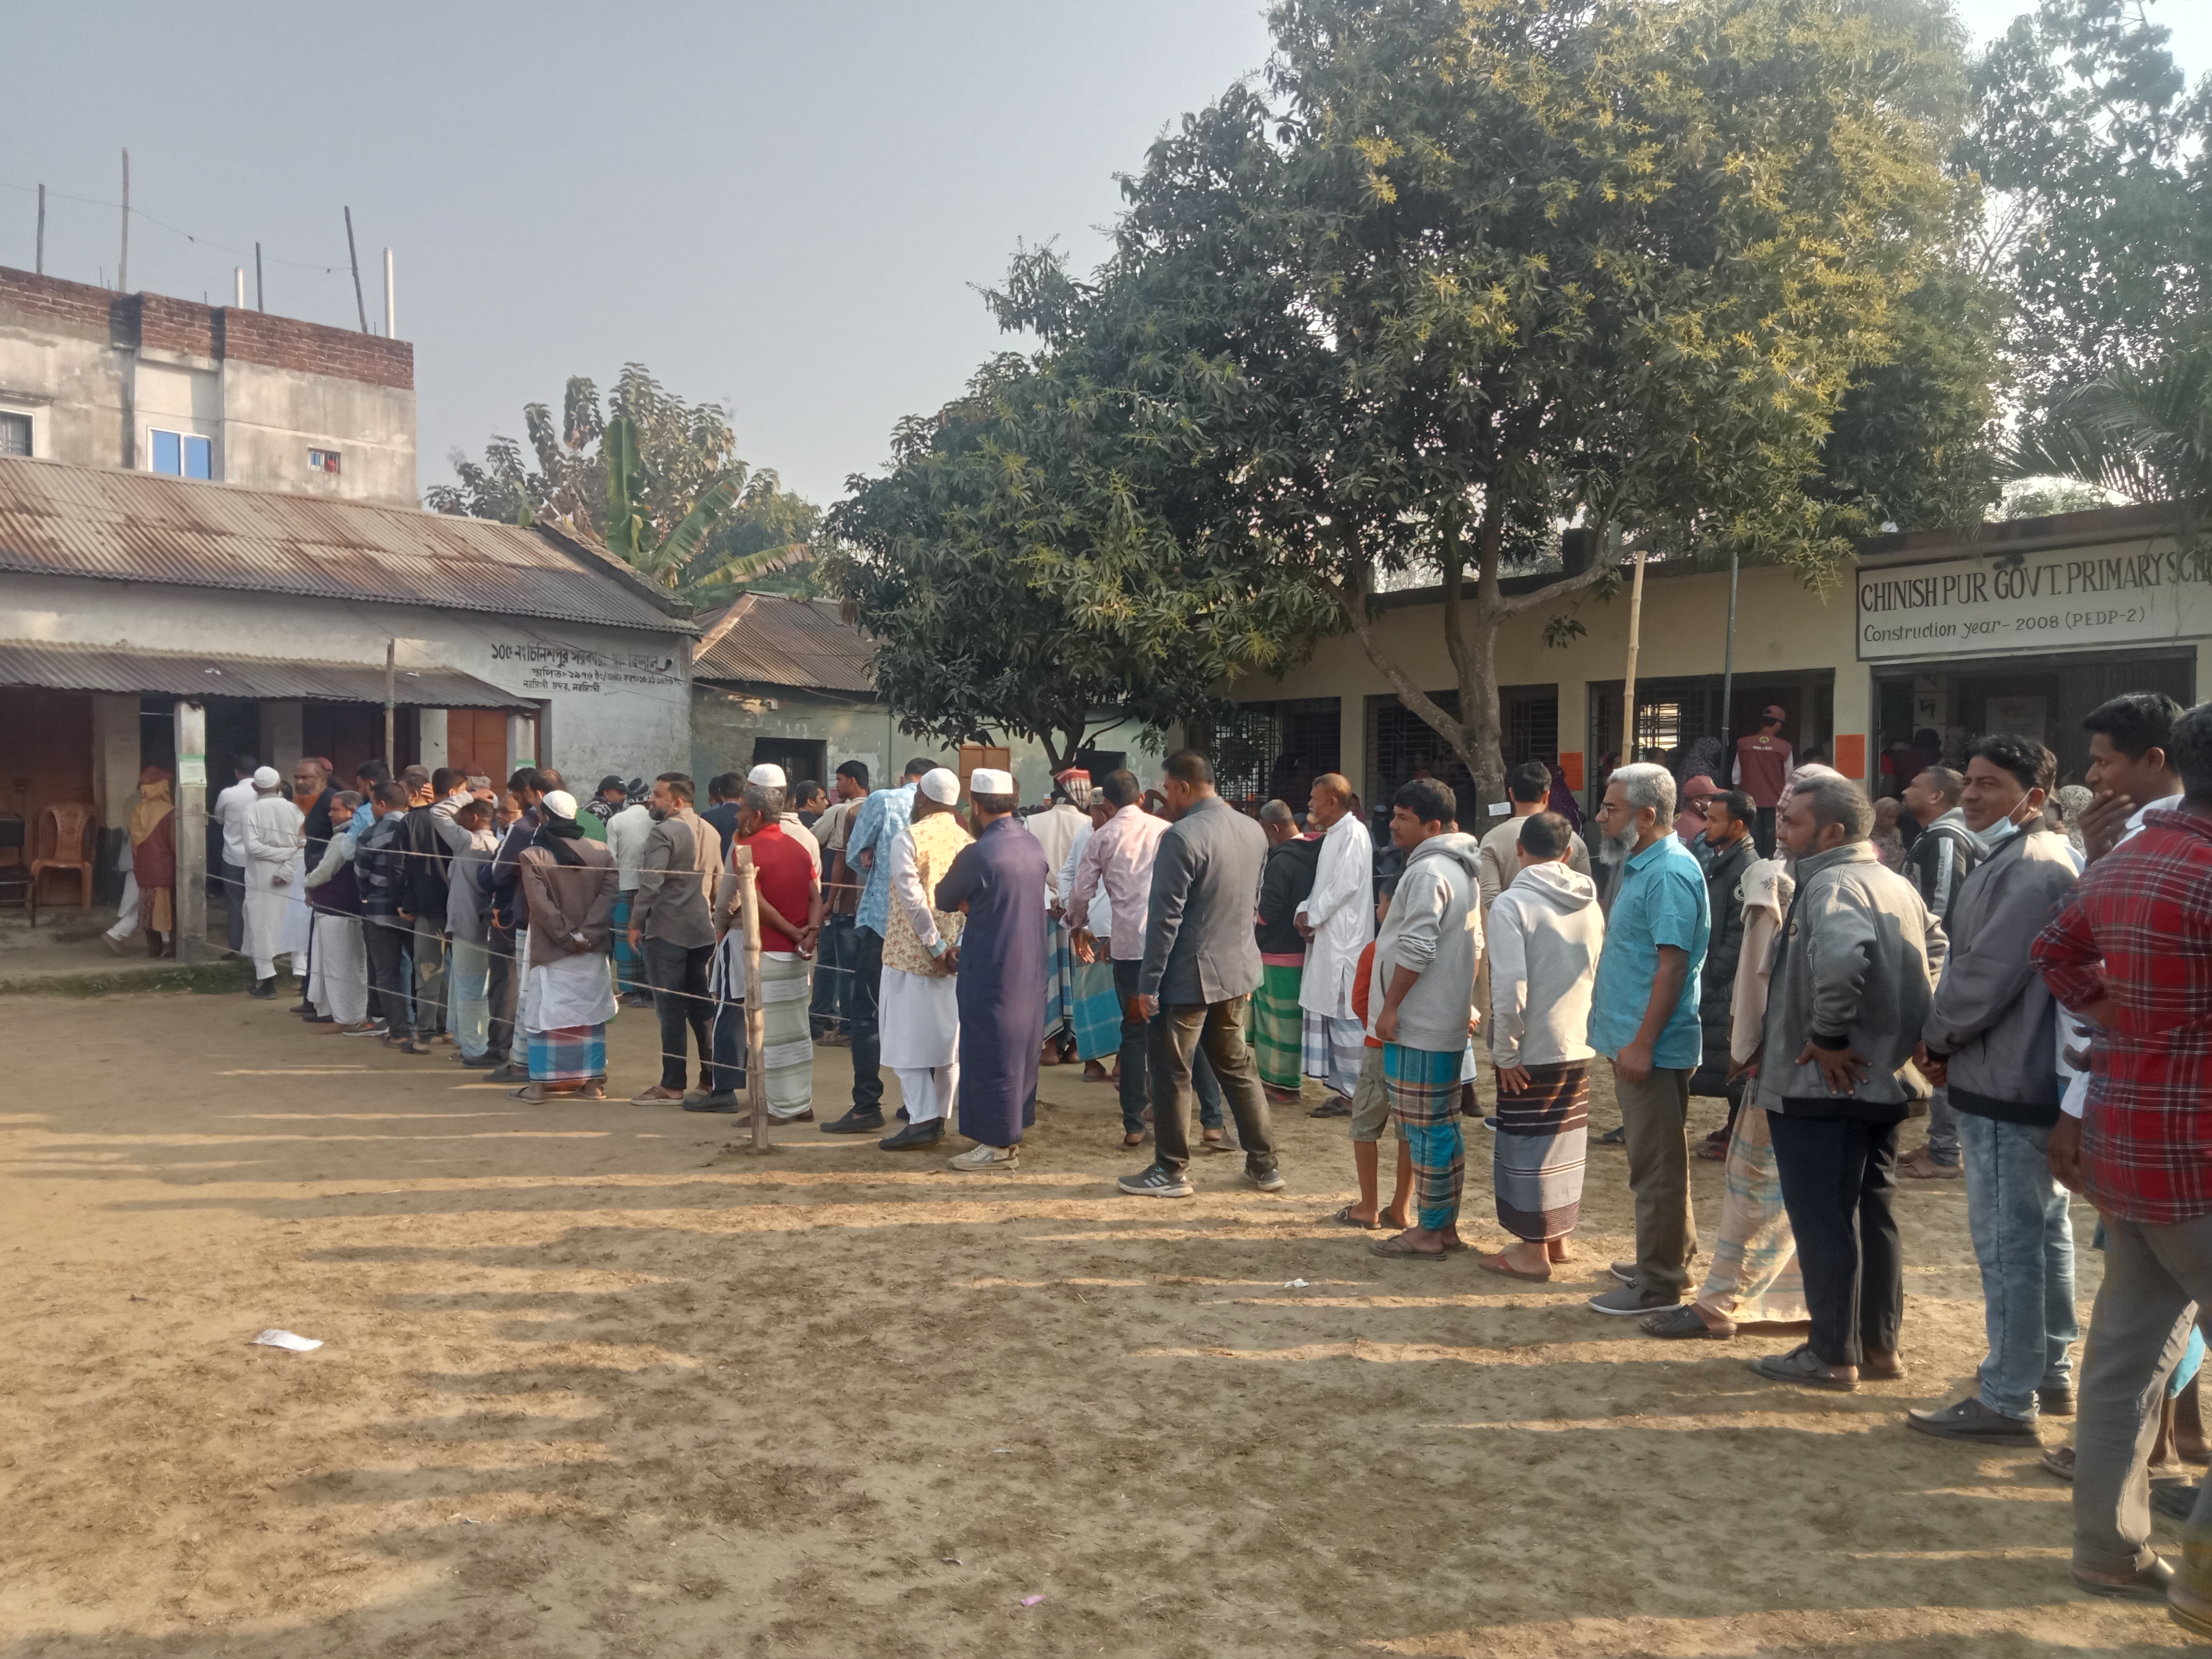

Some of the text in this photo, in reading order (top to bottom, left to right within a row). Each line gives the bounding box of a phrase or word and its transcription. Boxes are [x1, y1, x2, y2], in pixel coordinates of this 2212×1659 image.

[2066, 553, 2164, 594] PRIMARY
[1864, 622, 1957, 642] Construction
[2016, 615, 2059, 631] 2008
[2065, 606, 2145, 630] (PEDP-2)
